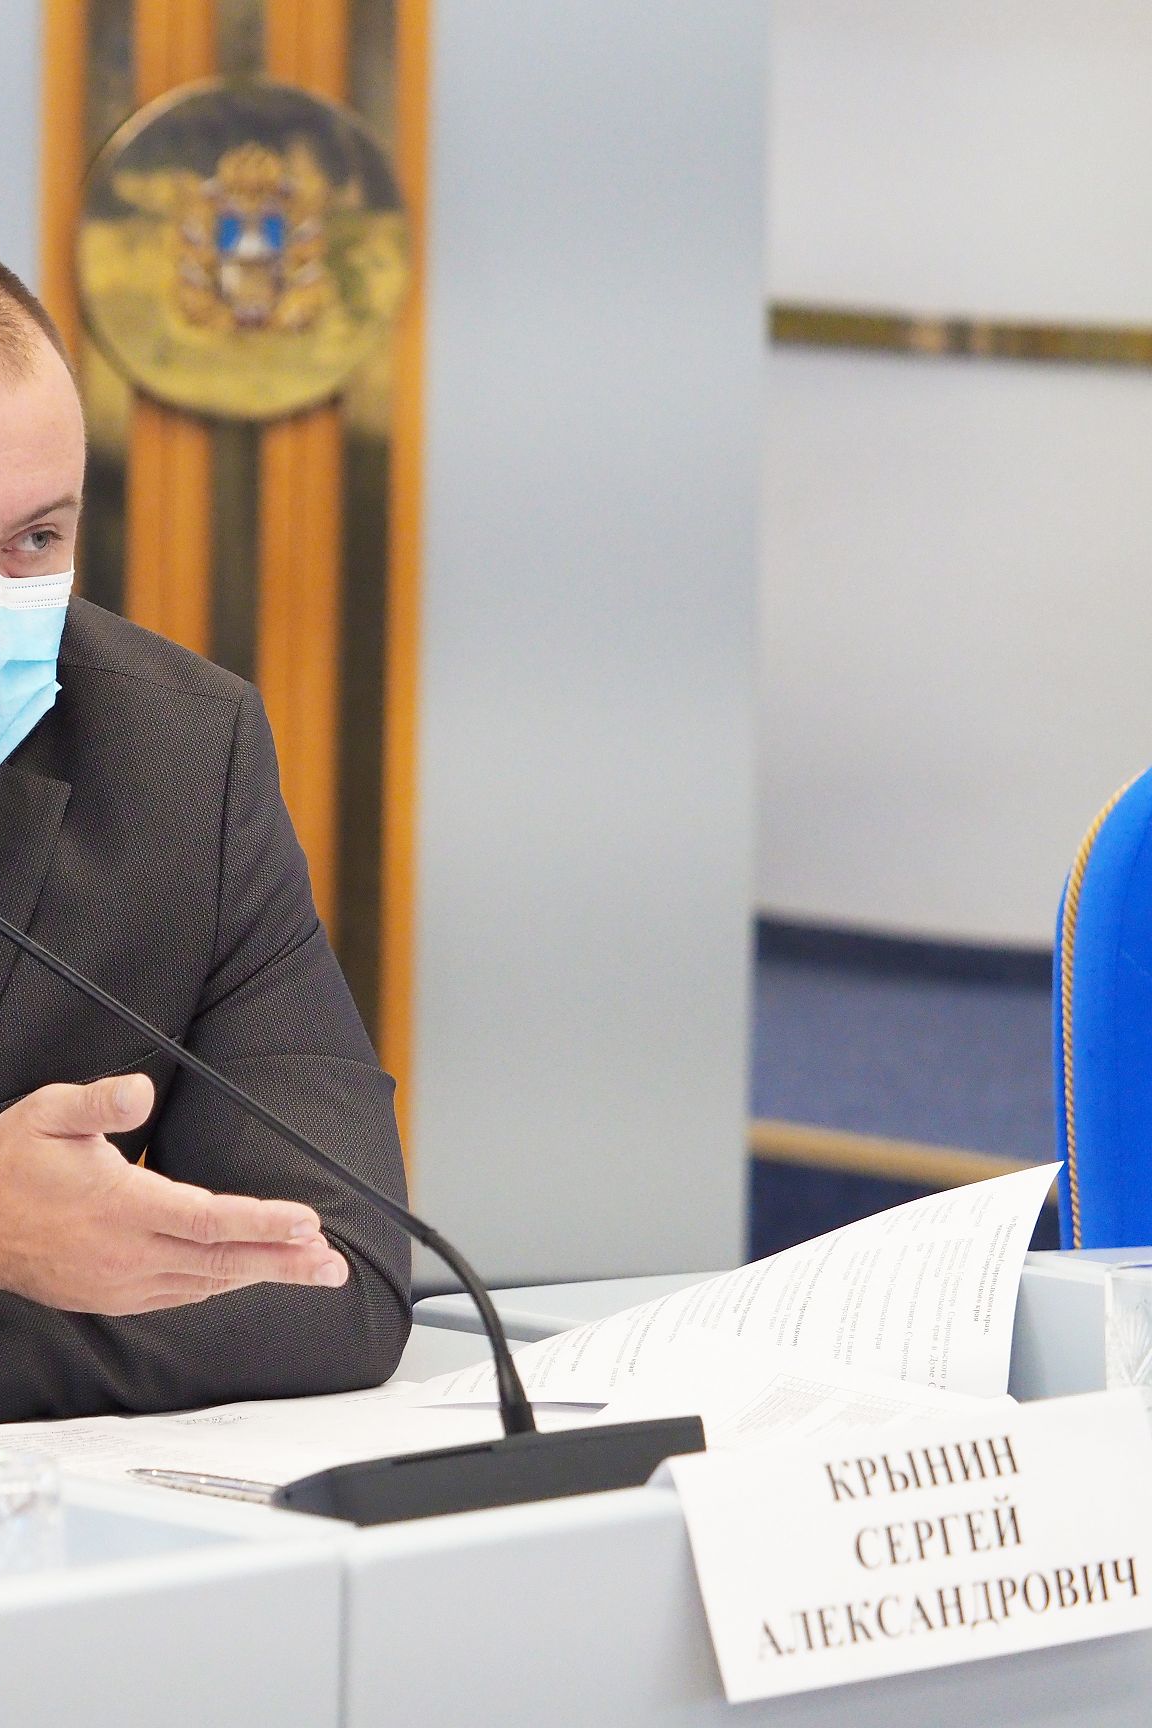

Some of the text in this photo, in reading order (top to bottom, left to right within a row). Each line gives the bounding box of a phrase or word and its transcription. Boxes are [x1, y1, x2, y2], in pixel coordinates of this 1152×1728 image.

[824, 1436, 1020, 1502] КРЫНИН
[853, 1496, 1022, 1570] СЕРГЕЙ
[756, 1557, 1141, 1660] АЛЕКСАНДРОВИЧ
